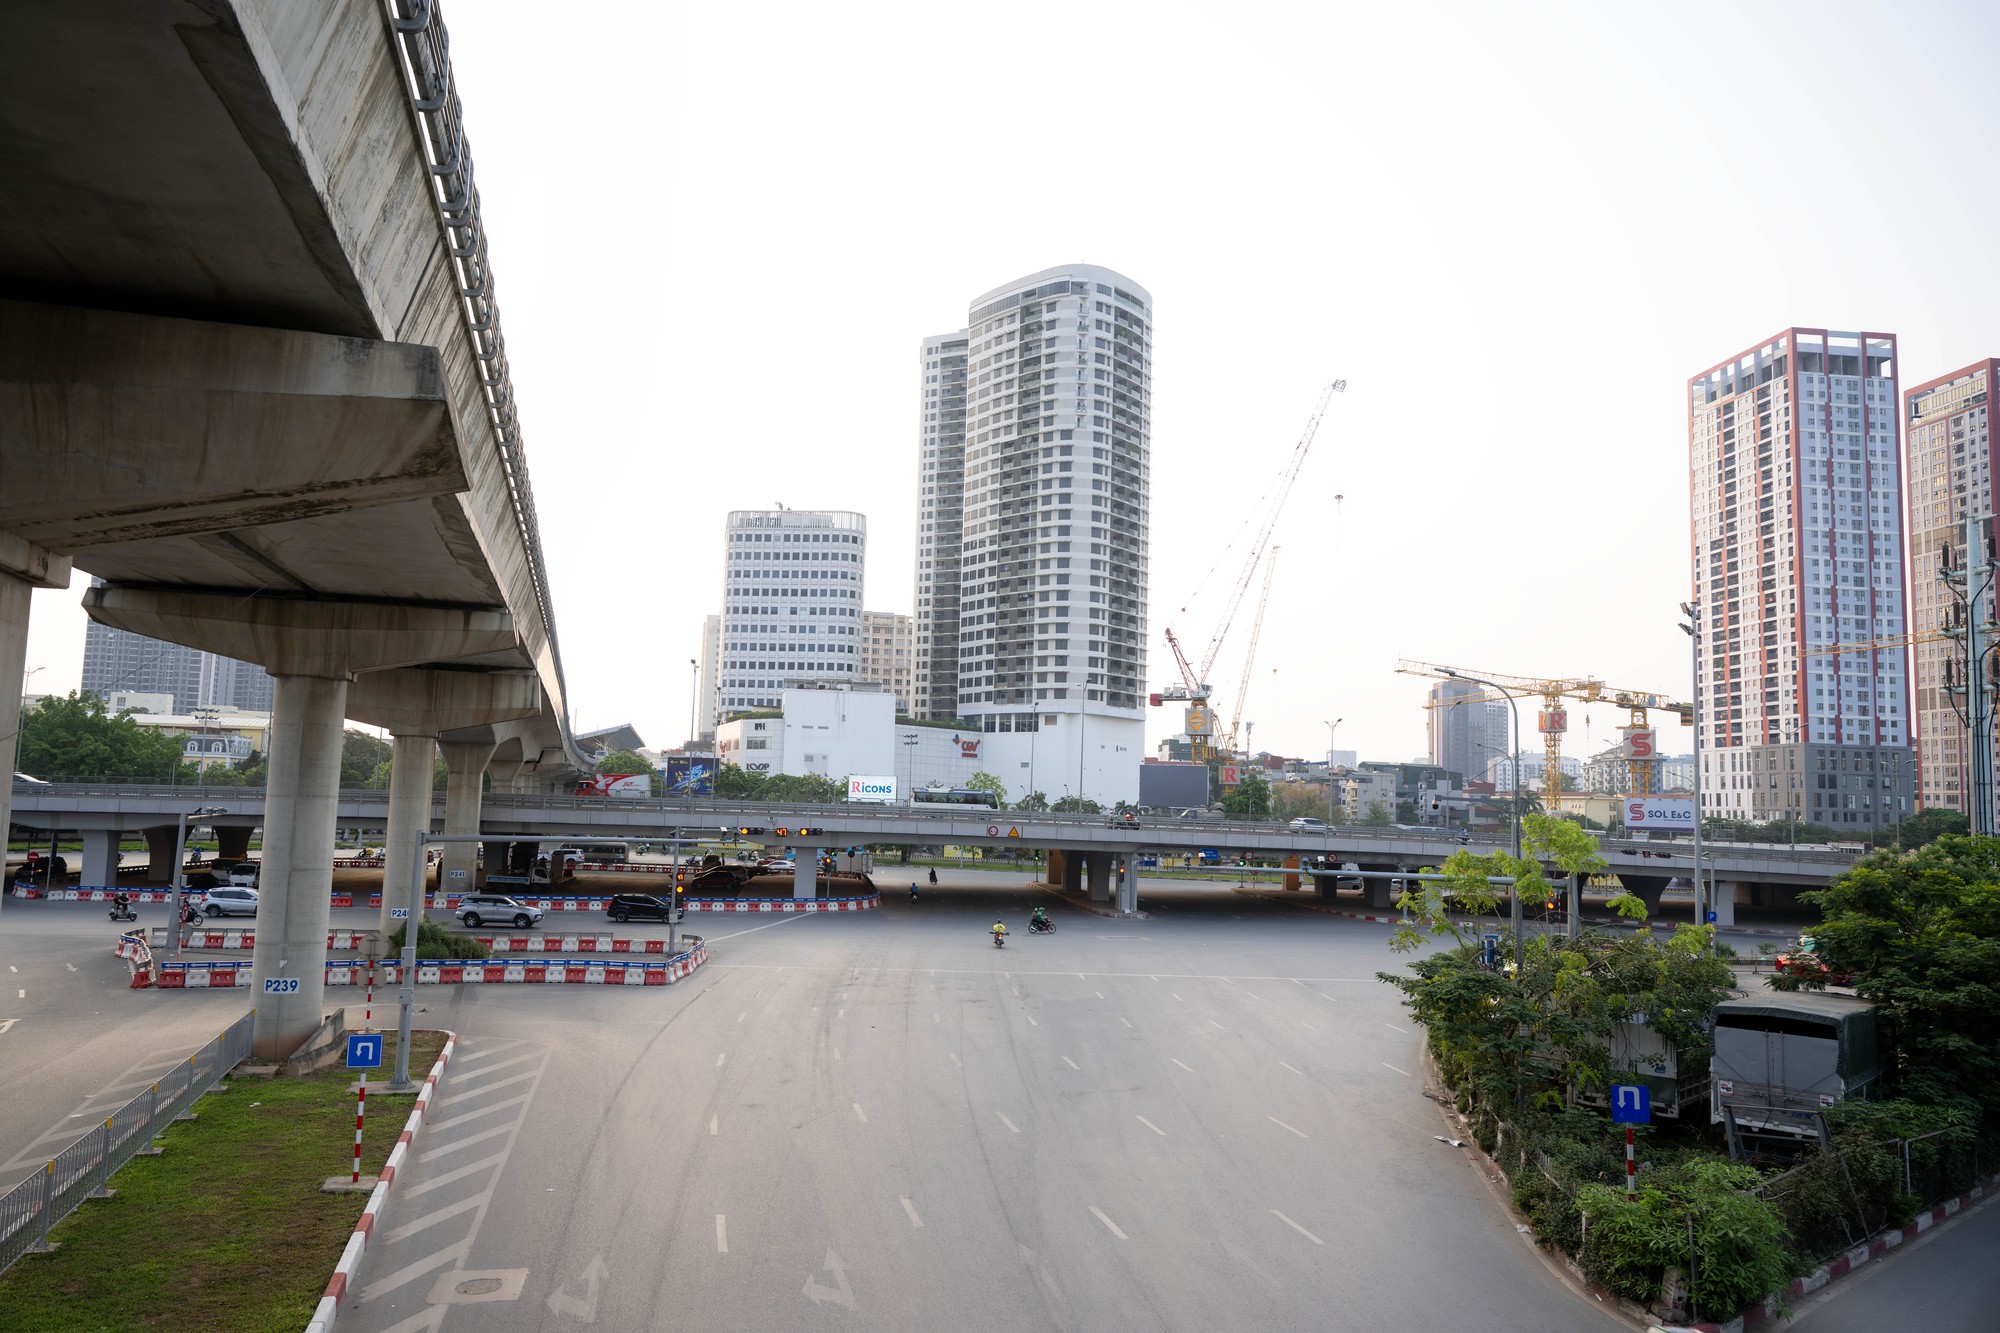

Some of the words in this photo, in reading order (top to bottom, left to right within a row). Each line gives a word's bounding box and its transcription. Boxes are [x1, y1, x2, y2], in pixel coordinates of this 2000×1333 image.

[754, 722, 766, 730] IPH
[1549, 712, 1565, 730] R
[962, 740, 978, 752] CGV
[746, 762, 770, 770] LOOP
[1223, 767, 1237, 782] R
[1648, 810, 1668, 818] SOL
[1671, 810, 1692, 819] E&C
[776, 828, 787, 836] 47
[265, 980, 298, 992] P239
